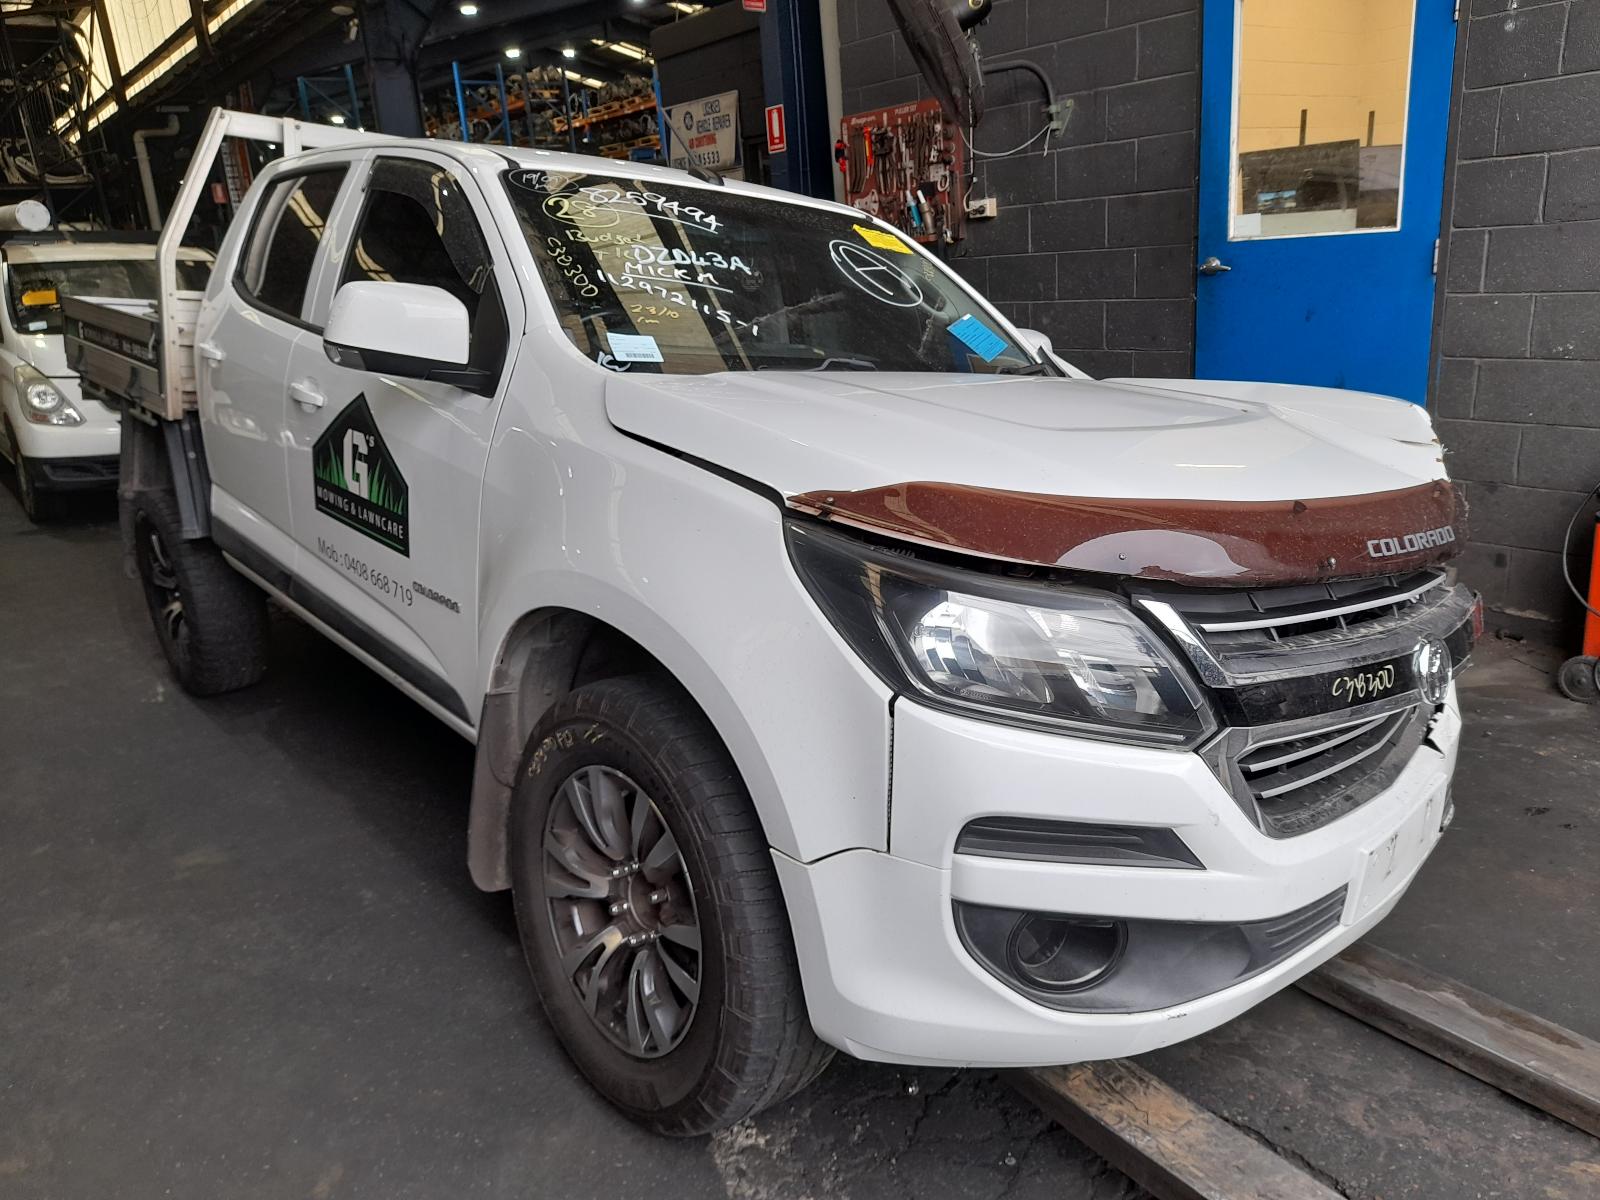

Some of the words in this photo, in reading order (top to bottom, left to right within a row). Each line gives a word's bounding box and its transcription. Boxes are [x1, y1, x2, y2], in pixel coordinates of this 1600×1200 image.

[316, 485, 350, 512] MOWING
[358, 507, 404, 539] LAWNCARE
[1366, 525, 1456, 558] COLORADO
[343, 552, 369, 581] 0408
[370, 568, 390, 594] 668
[391, 579, 413, 606] 719
